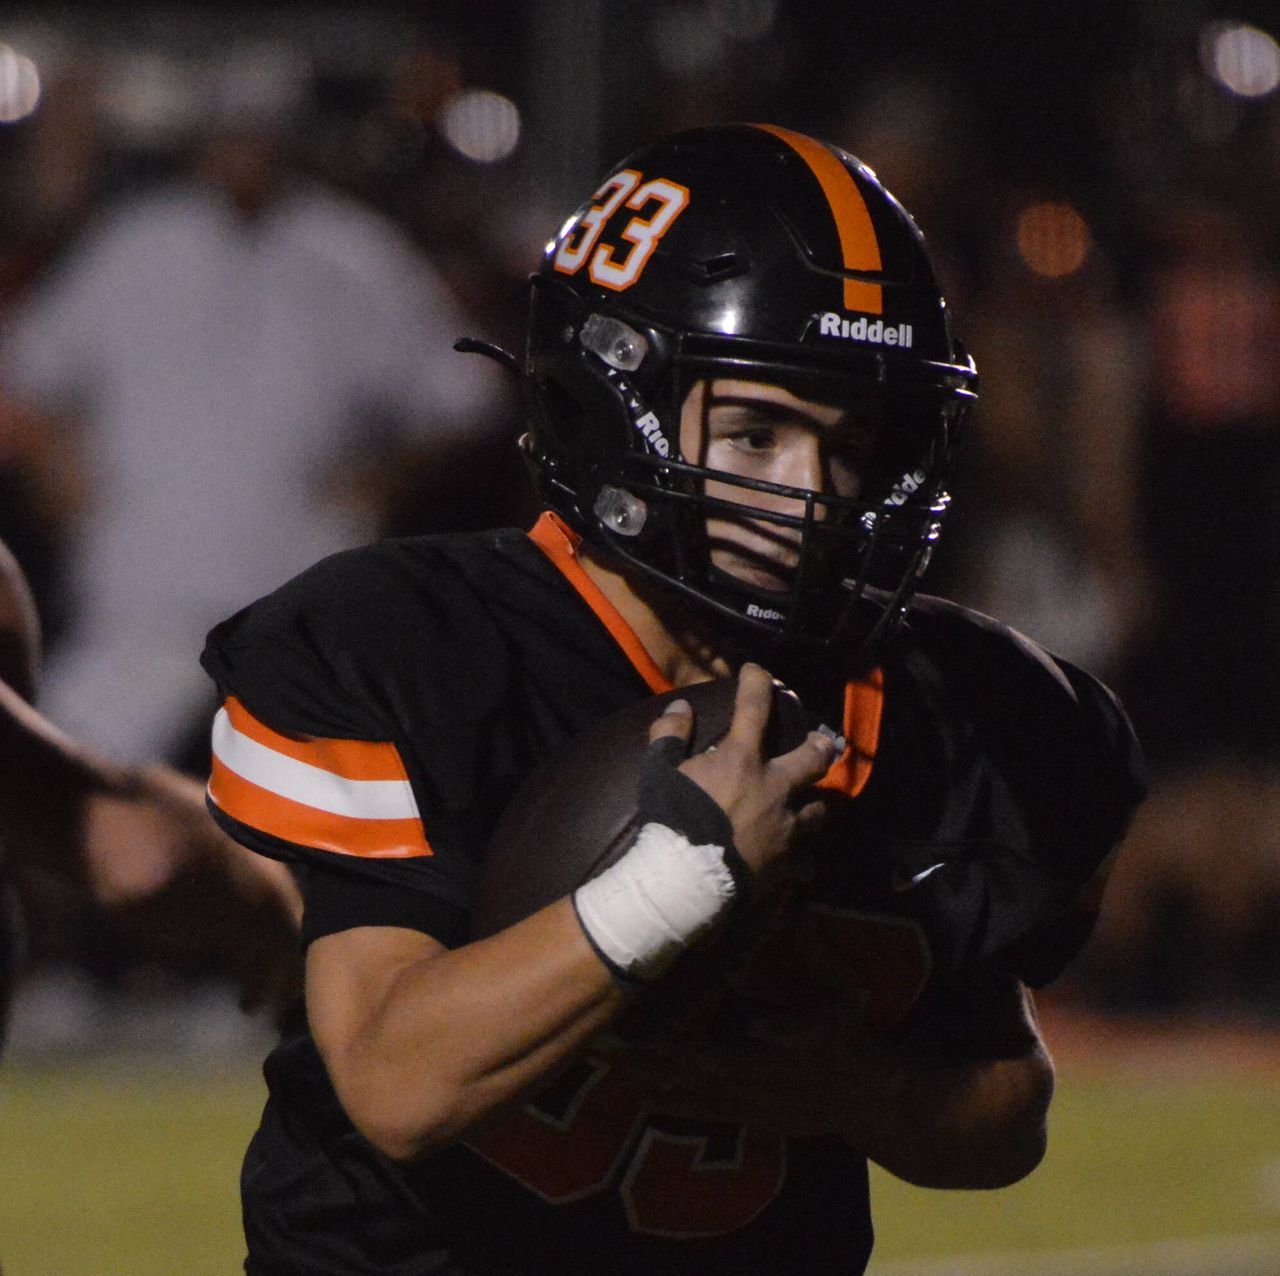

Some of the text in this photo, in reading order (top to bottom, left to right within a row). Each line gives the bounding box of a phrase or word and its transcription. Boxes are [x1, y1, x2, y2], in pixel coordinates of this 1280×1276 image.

[554, 168, 691, 293] 33
[820, 312, 913, 348] Riddell
[746, 603, 786, 620] Ridd
